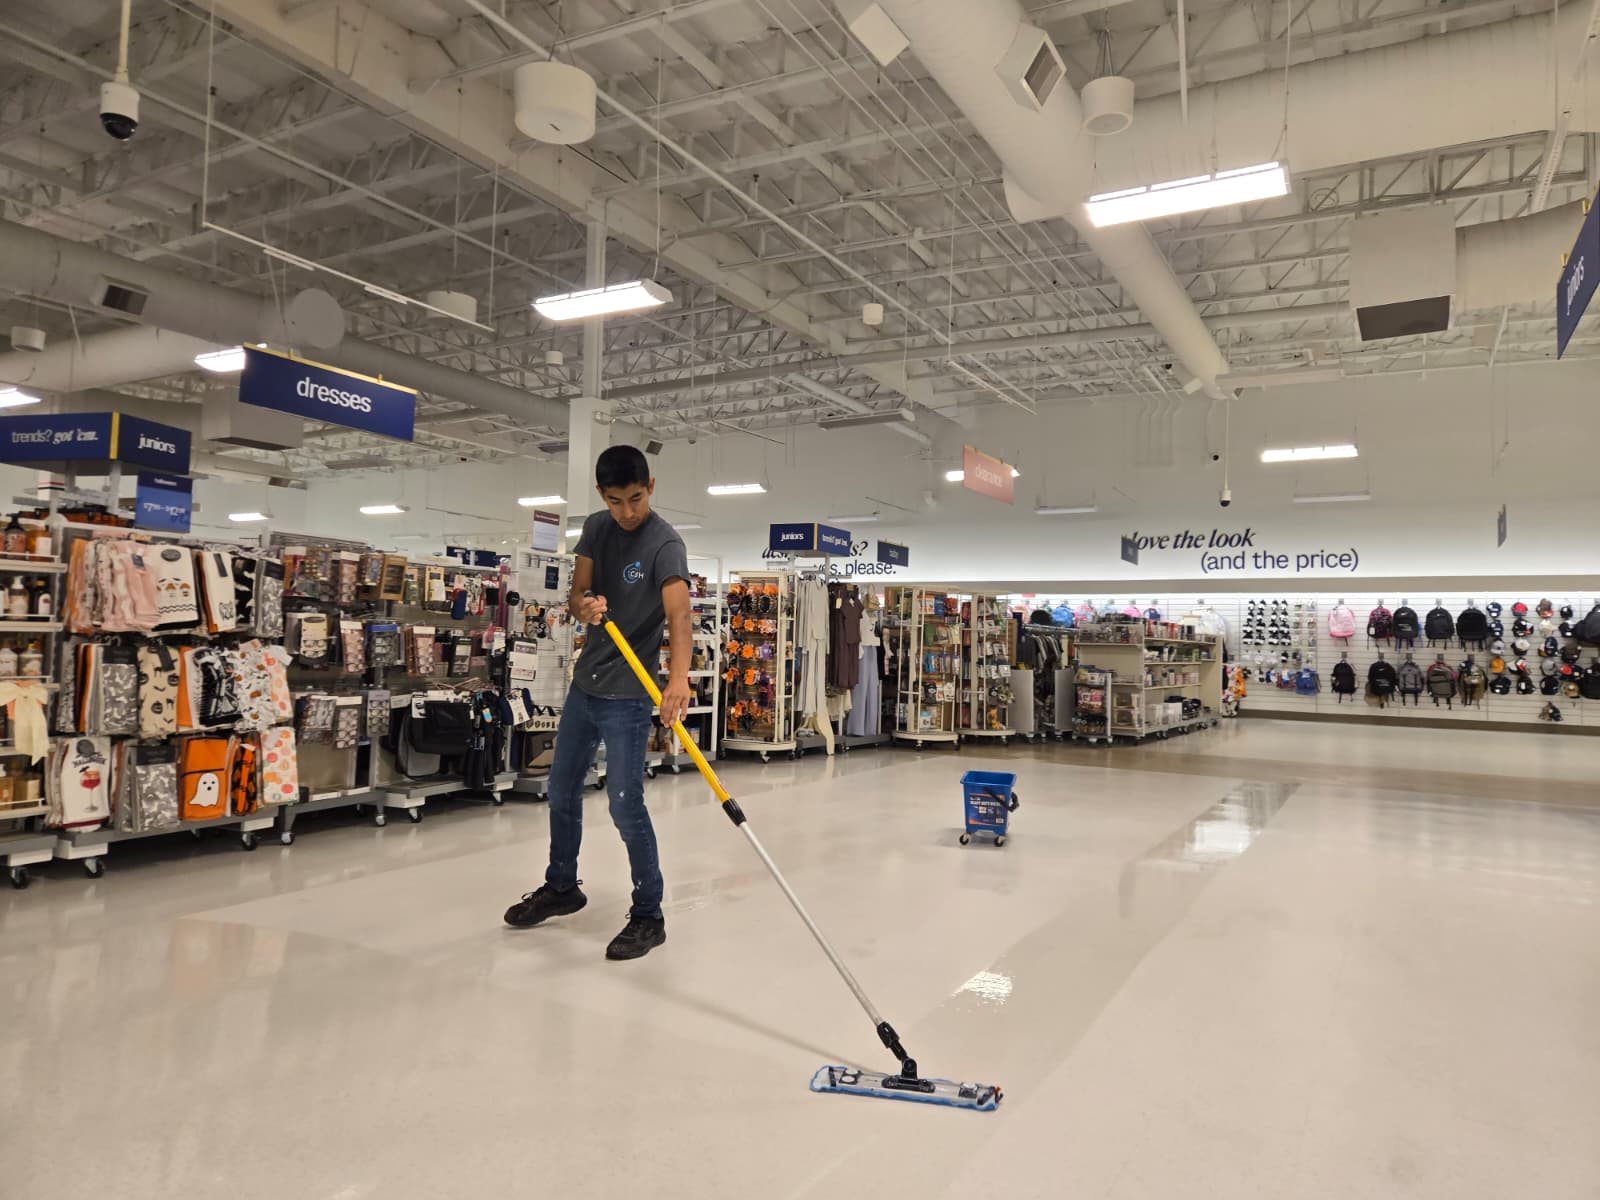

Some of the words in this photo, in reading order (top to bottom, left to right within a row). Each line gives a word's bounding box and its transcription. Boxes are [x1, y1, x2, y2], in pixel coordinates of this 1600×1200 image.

[296, 376, 372, 413] dresses
[12, 429, 52, 443] trends?
[52, 430, 74, 445] got
[137, 433, 177, 454] juniors
[780, 532, 805, 542] juniors
[1172, 529, 1205, 549] the
[1208, 528, 1256, 548] look
[1200, 551, 1245, 574] (and
[1252, 550, 1289, 569] the
[1296, 548, 1359, 573] price)
